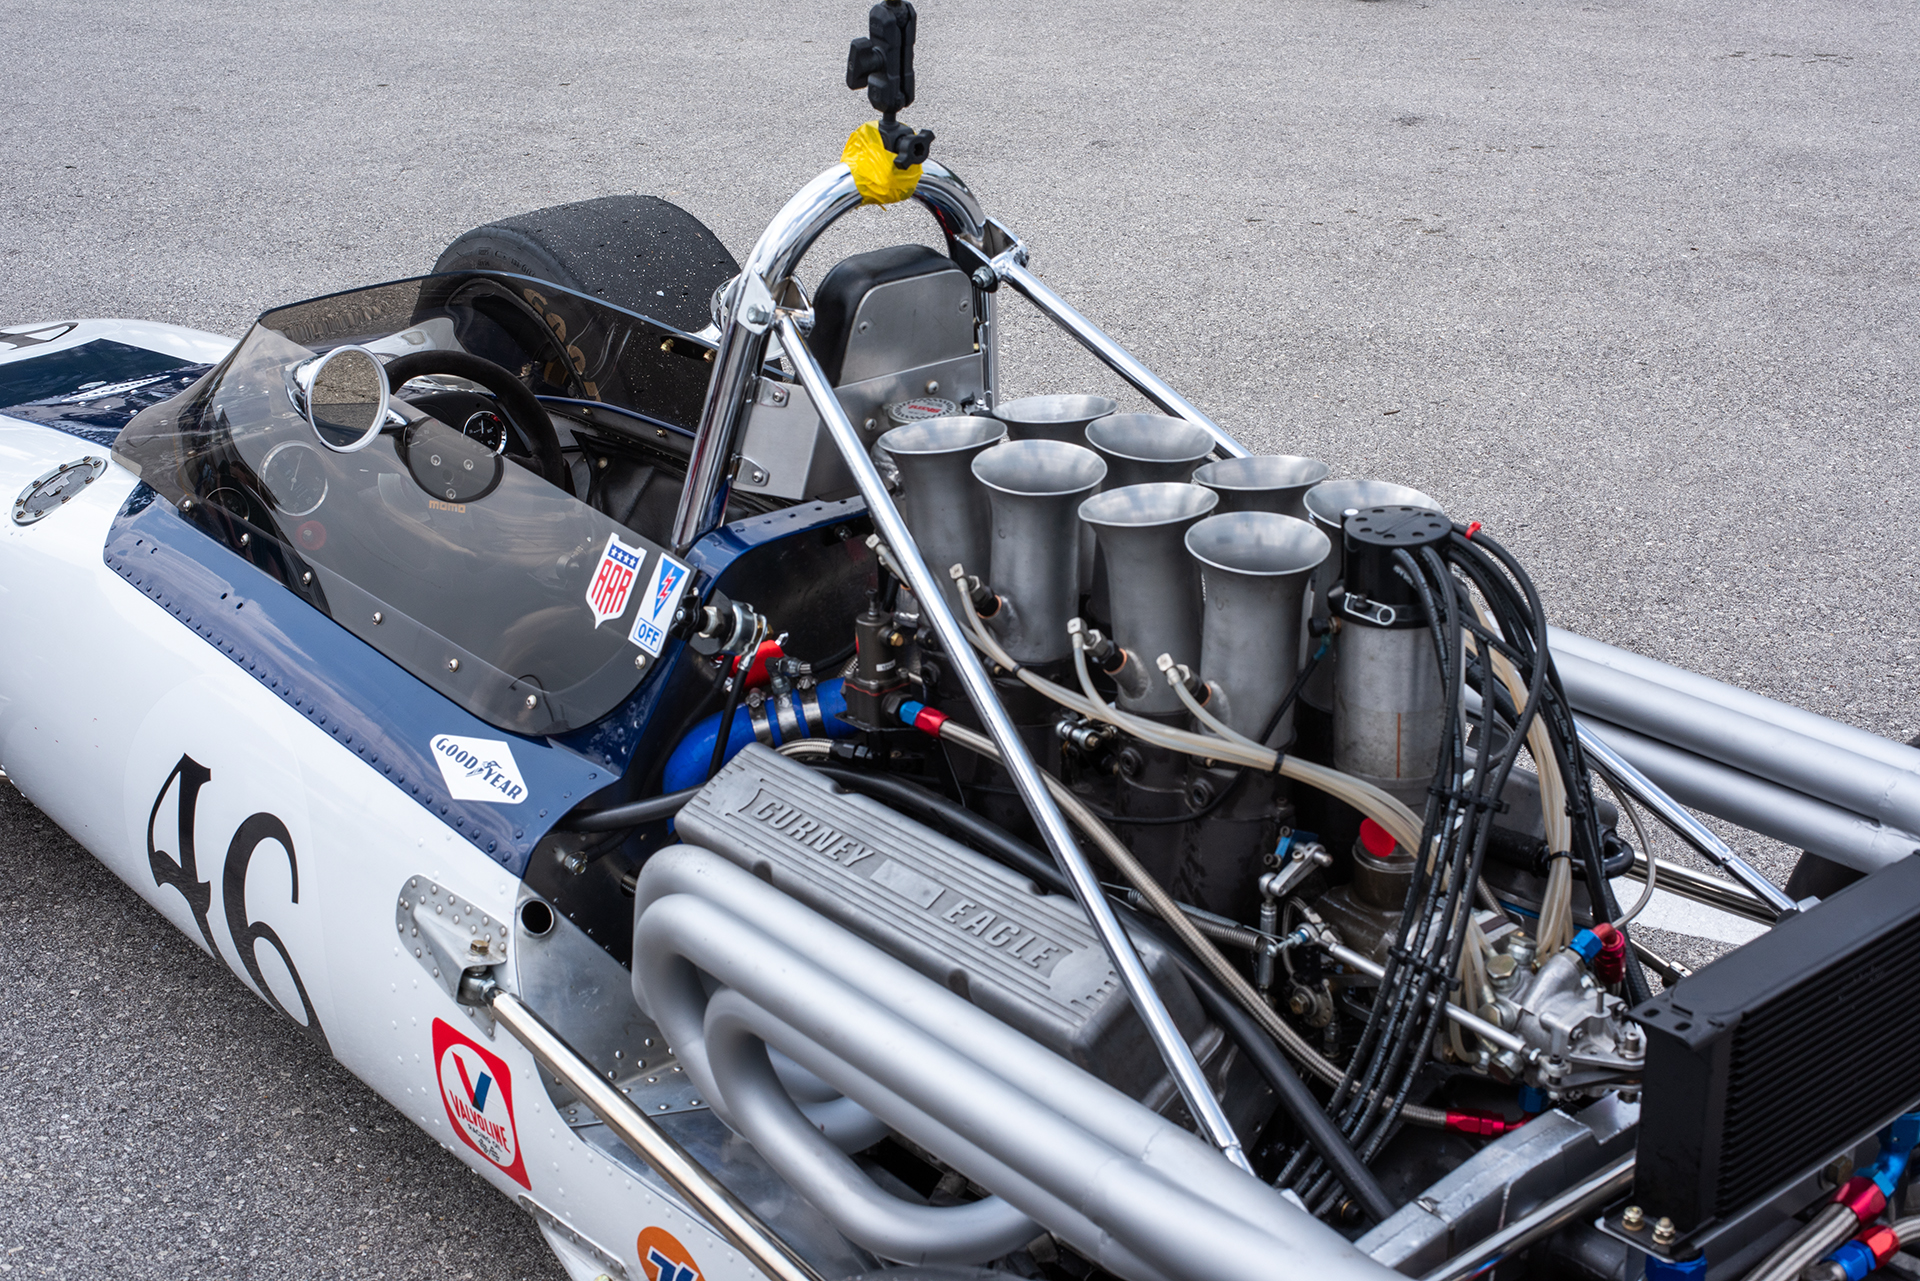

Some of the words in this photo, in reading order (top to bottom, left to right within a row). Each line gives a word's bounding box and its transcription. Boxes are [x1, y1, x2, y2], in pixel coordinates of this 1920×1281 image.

[591, 558, 634, 615] AAR
[637, 623, 660, 646] OFF
[435, 737, 479, 770] GOOD
[482, 765, 523, 800] YEAR
[750, 799, 875, 868] GURNEY
[147, 752, 334, 1056] 46
[941, 899, 1060, 969] EAGLE
[449, 1088, 511, 1154] VALVOLINE
